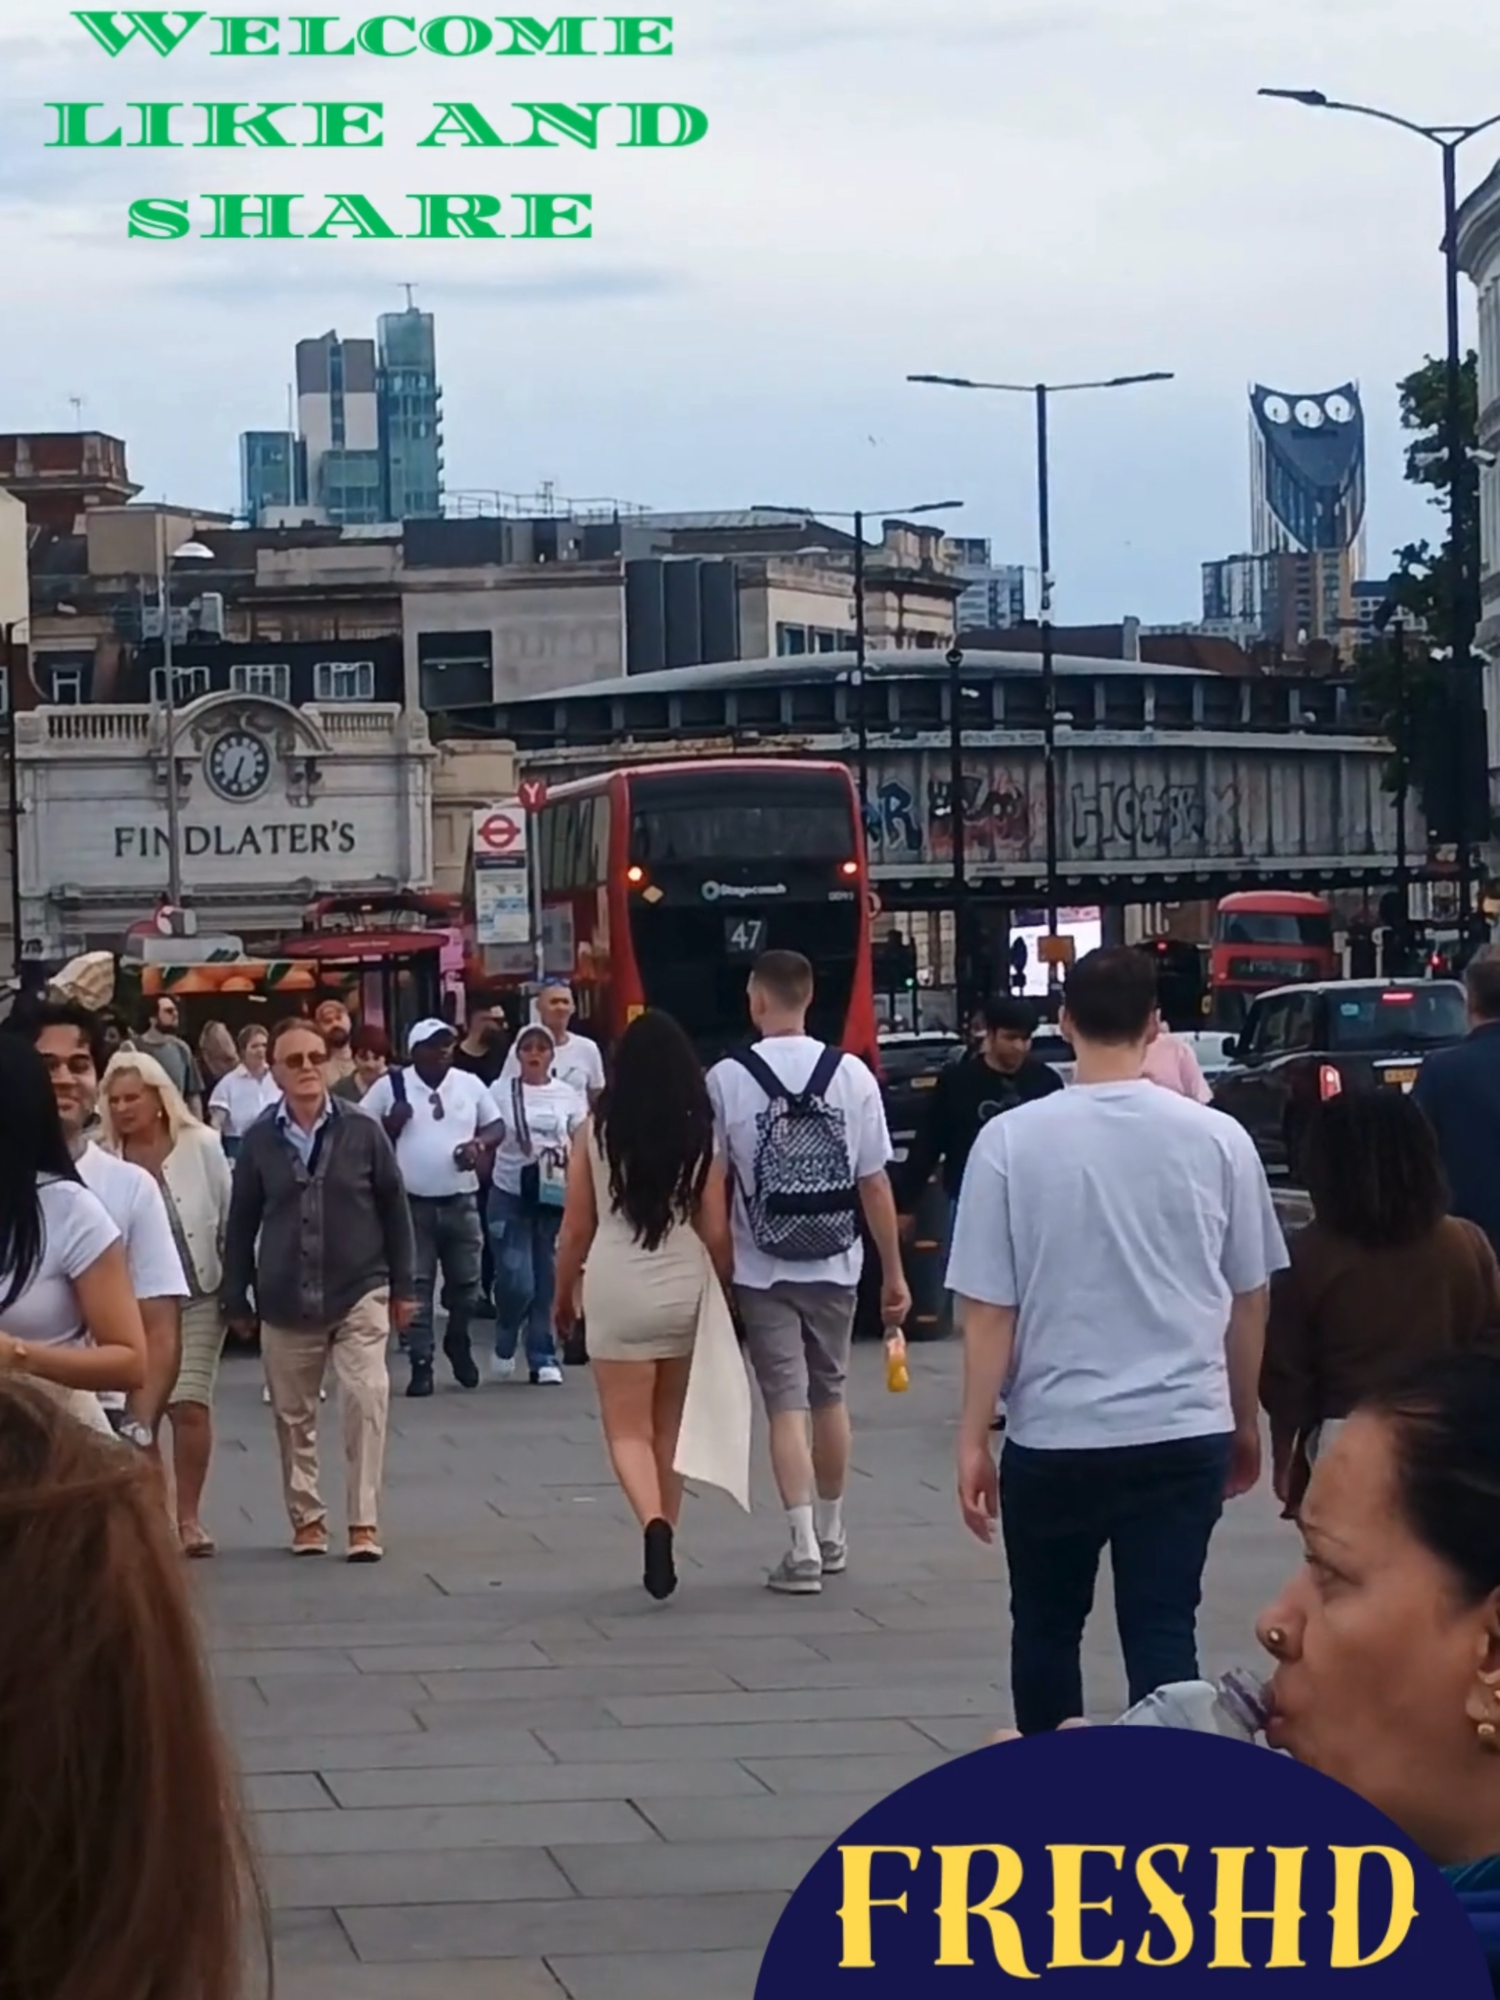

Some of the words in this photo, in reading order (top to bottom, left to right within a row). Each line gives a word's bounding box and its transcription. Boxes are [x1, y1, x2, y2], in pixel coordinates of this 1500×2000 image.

[523, 782, 541, 804] Y
[114, 820, 356, 857] FINDLATER'S
[731, 920, 763, 950] 47
